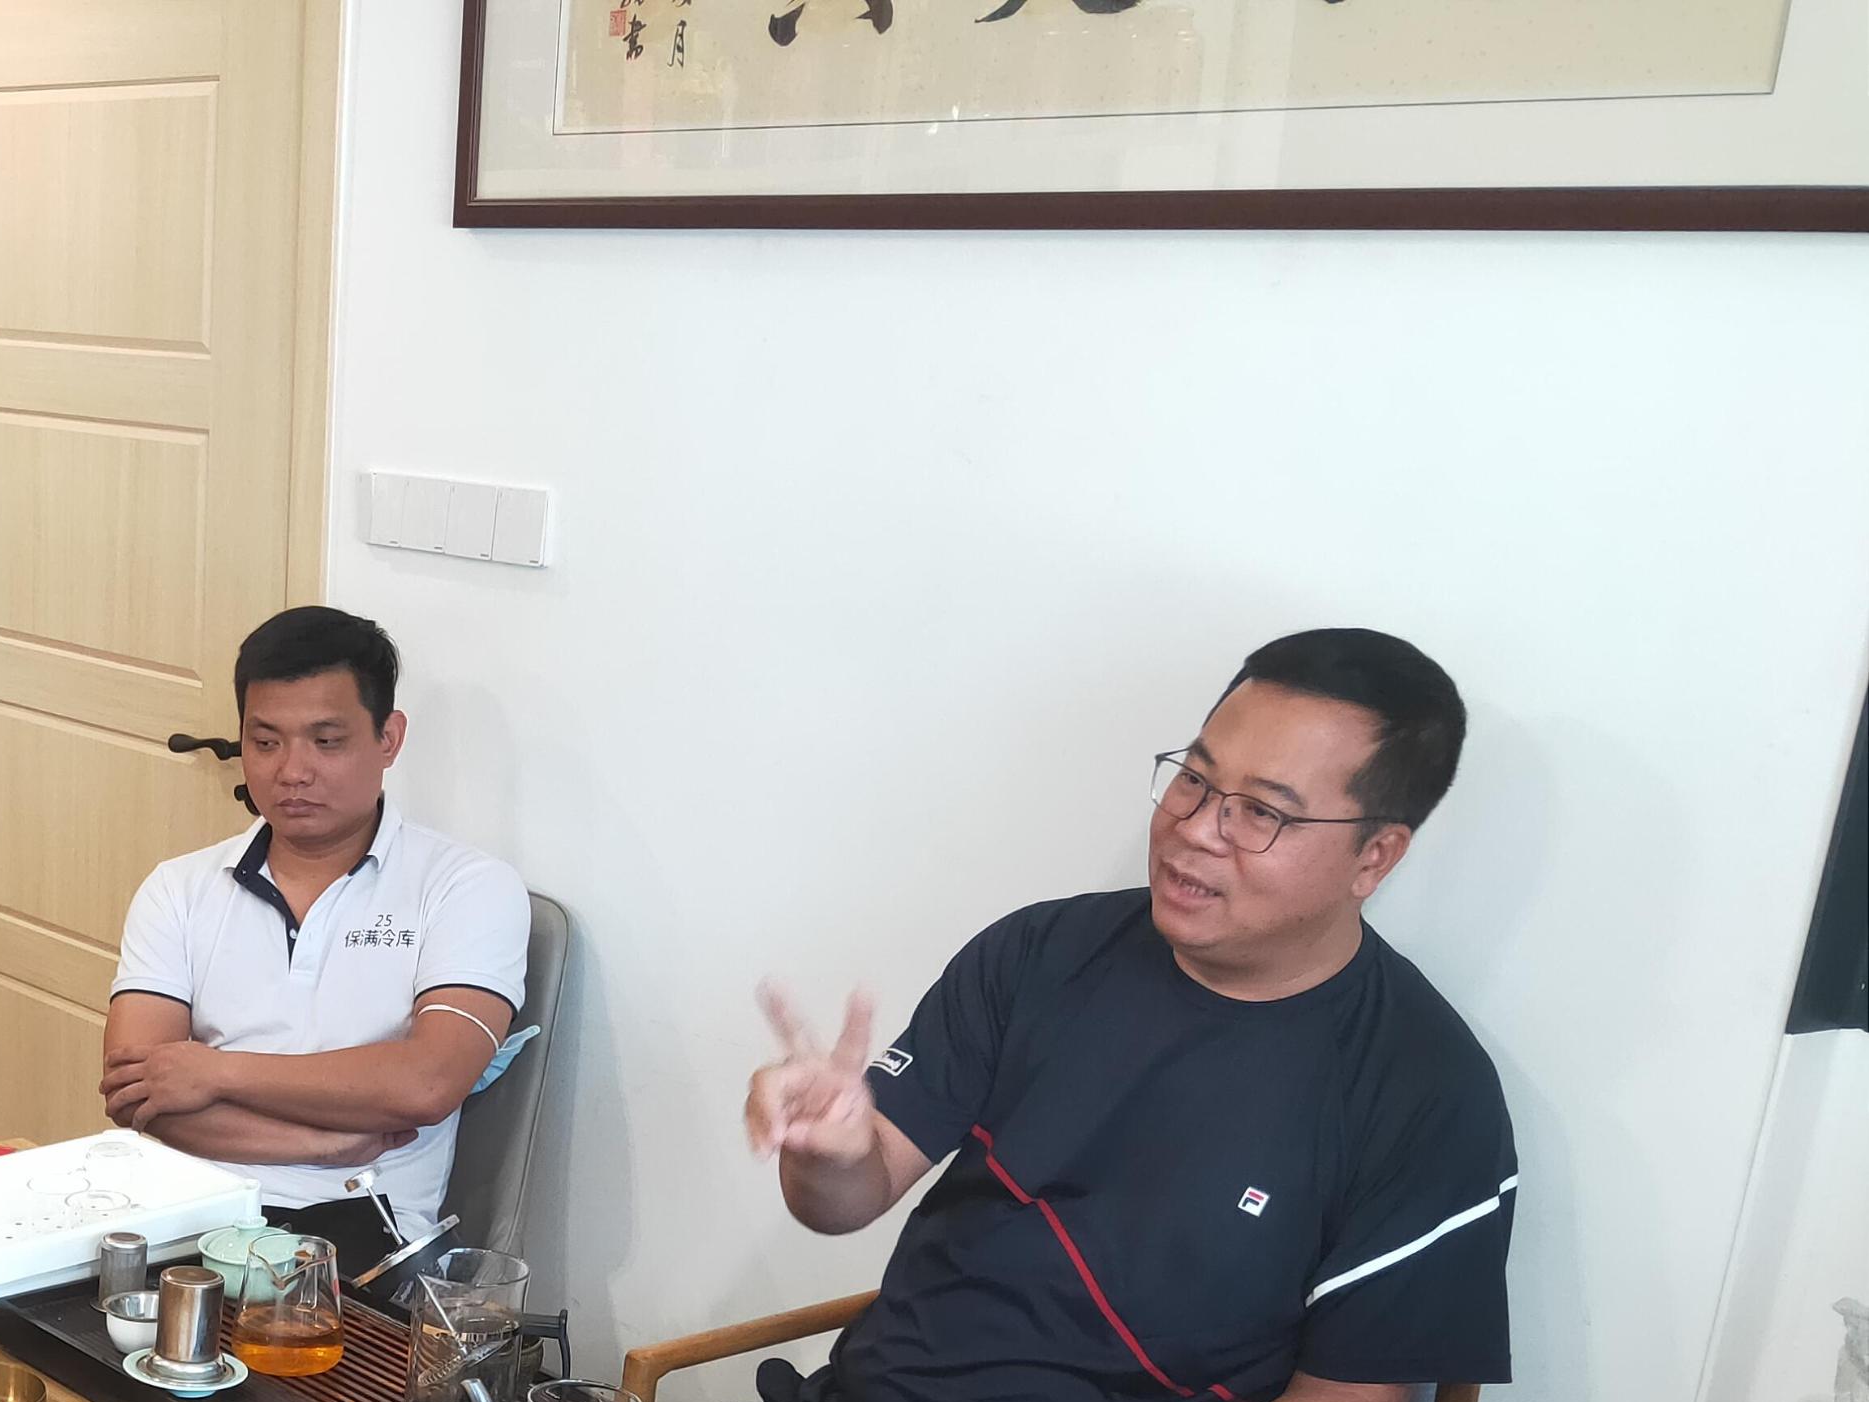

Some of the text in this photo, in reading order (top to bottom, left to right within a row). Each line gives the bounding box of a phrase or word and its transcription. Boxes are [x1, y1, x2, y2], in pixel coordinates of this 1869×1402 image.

[374, 914, 393, 927] 25
[344, 928, 416, 948] 保满冷库
